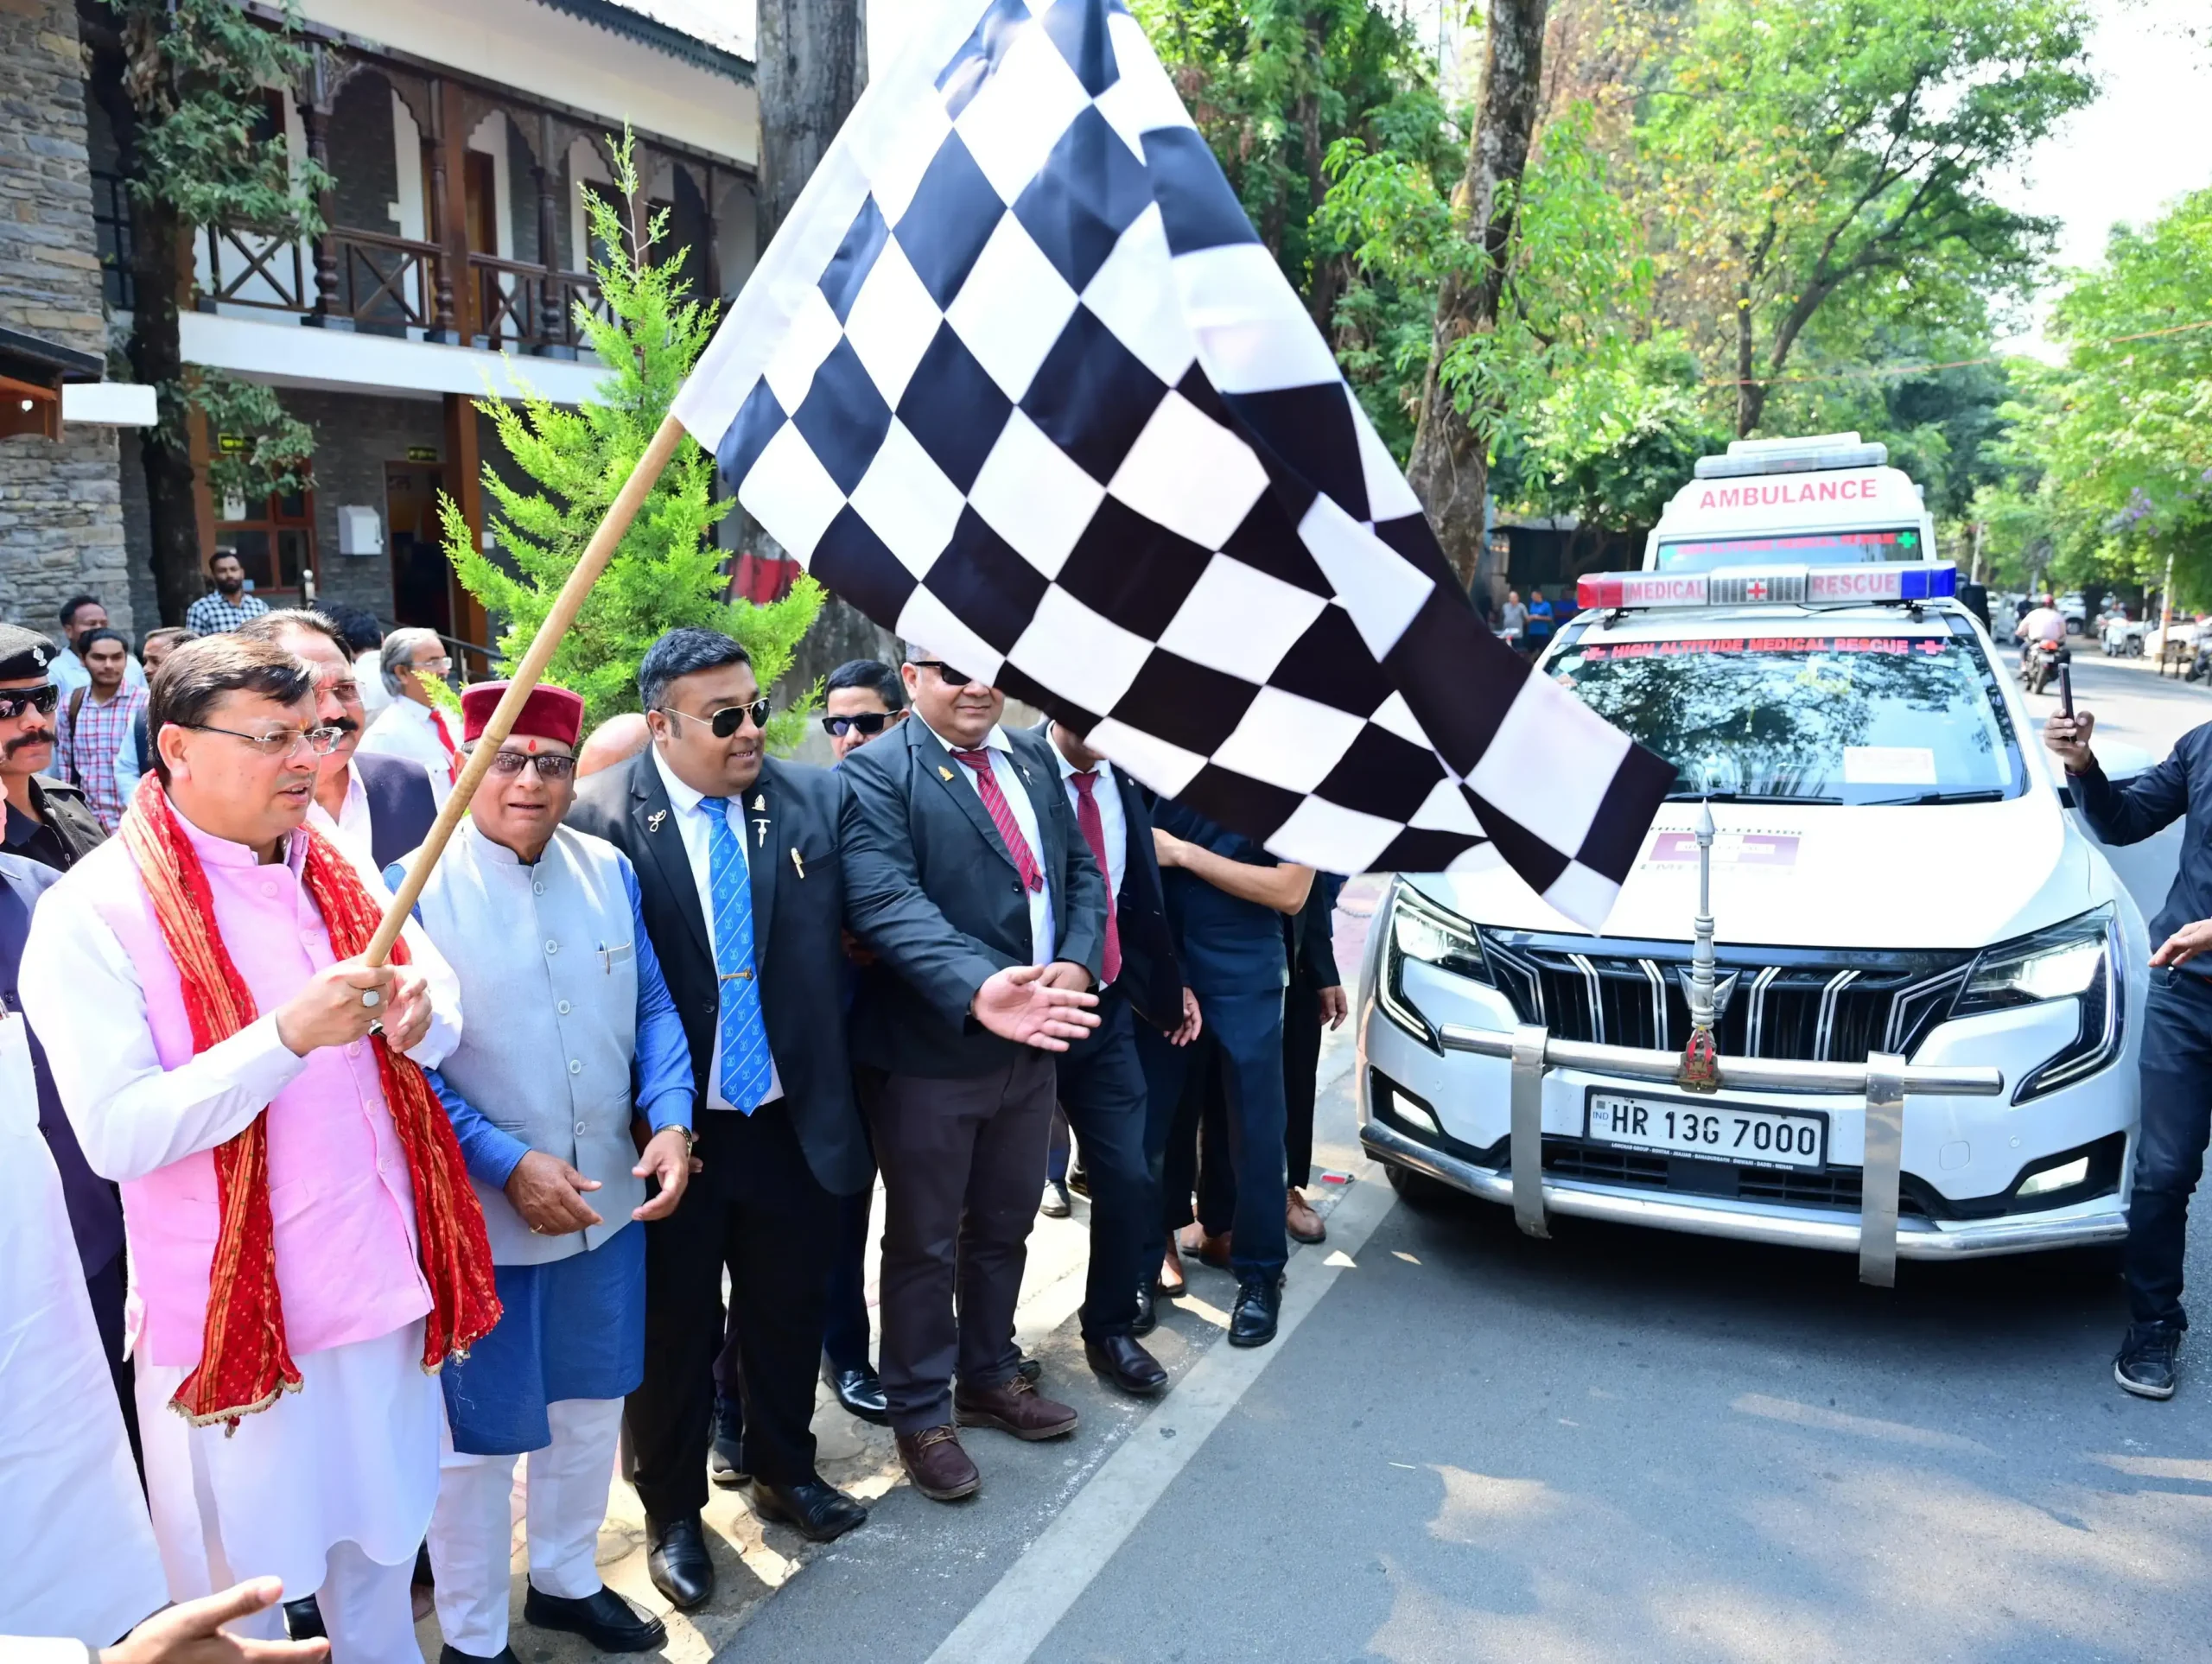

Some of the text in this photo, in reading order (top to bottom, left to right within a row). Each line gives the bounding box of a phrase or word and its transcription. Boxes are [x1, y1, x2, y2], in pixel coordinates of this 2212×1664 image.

[1700, 479, 1877, 509] AMBULANCE
[1630, 580, 1706, 600] MEDICAL
[1814, 573, 1897, 594] RESCUE
[1611, 638, 1909, 658] HIGH ALTITUDE MEDICAL RESCUE
[1592, 1111, 1609, 1121] IND
[1611, 1104, 1815, 1155] HR 13G 7000
